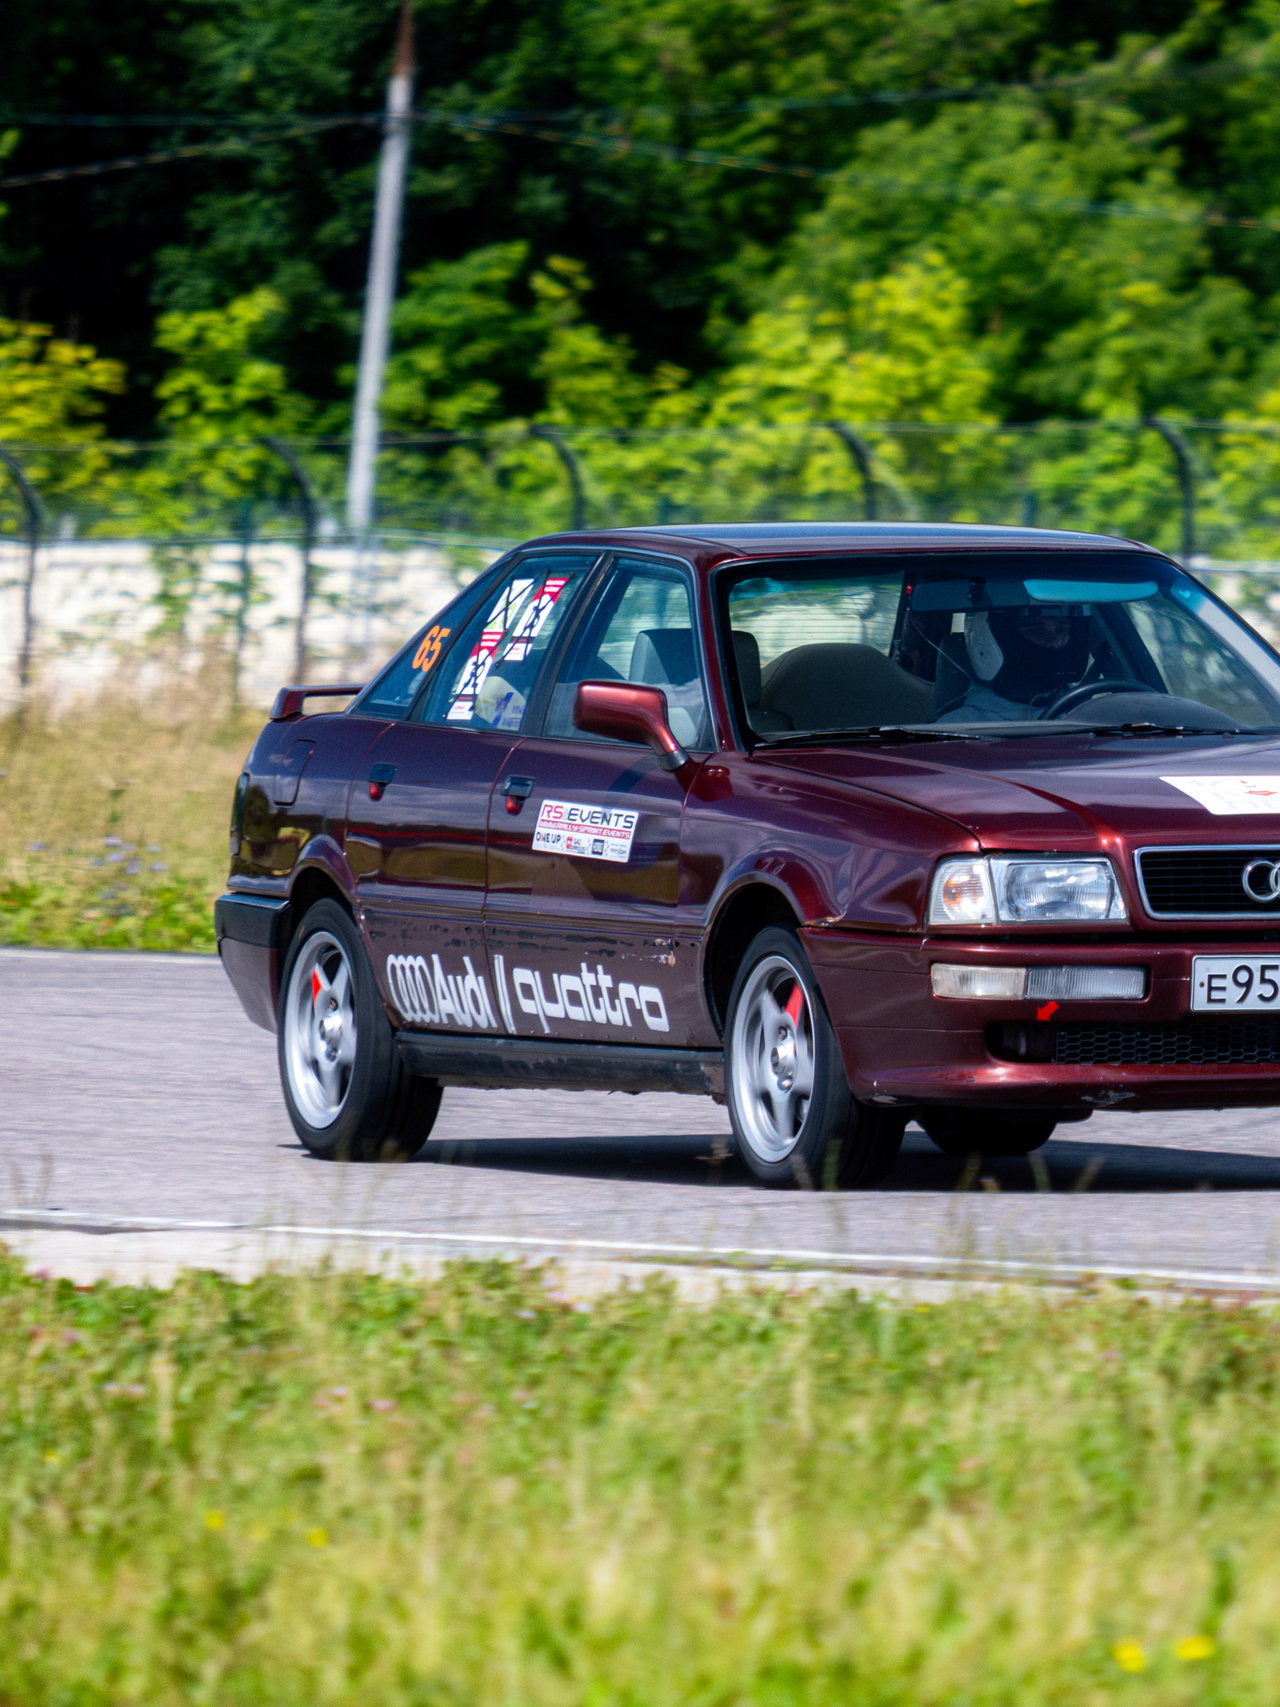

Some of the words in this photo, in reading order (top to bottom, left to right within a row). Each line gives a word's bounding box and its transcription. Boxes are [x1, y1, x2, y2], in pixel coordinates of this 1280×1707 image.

[412, 625, 451, 672] 65
[535, 831, 551, 843] ONE
[551, 834, 562, 845] UP
[541, 804, 564, 820] RS
[567, 807, 636, 829] EVENTS
[431, 953, 498, 1029] Audi
[513, 962, 670, 1034] quattro
